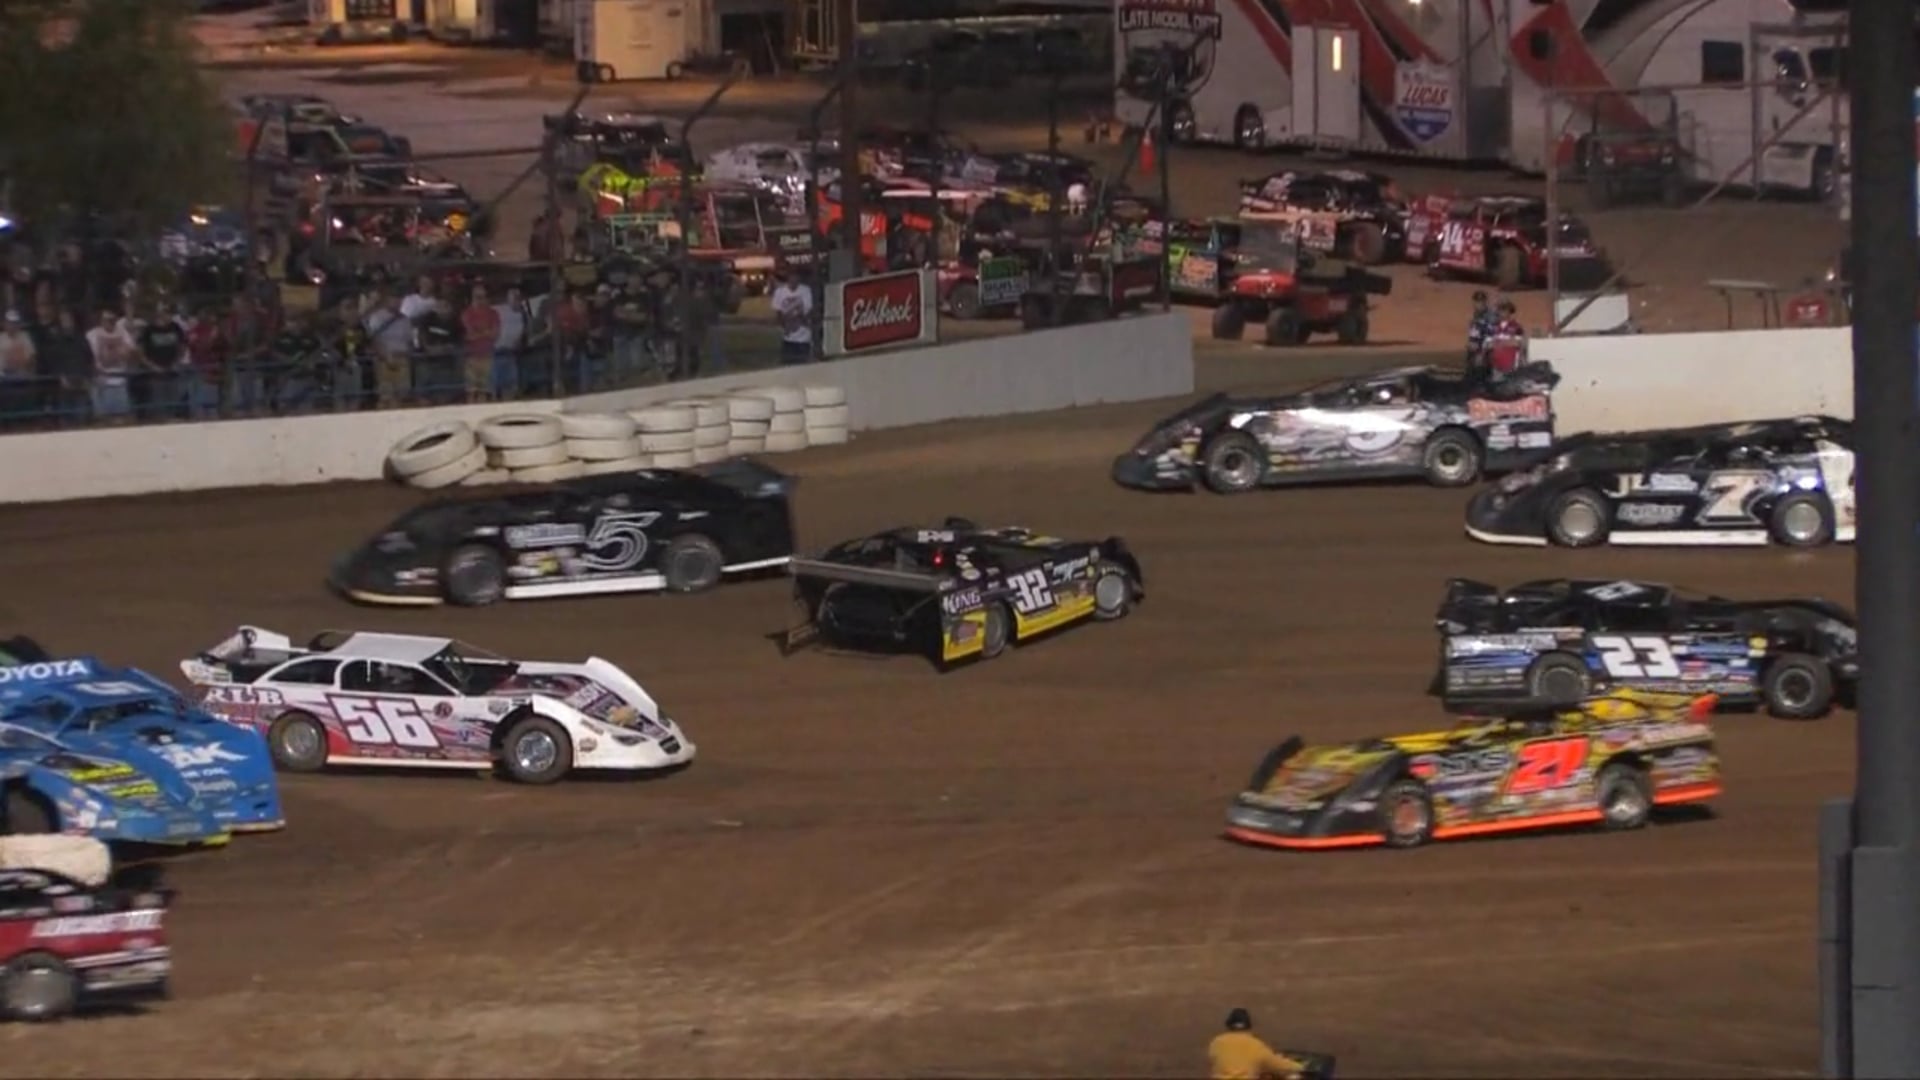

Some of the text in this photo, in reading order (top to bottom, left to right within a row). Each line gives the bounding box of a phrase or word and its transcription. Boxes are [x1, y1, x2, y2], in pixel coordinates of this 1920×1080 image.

[1121, 9, 1219, 38] LATE MODEL DT
[1403, 85, 1449, 106] LUCAS
[1441, 222, 1465, 254] 14
[850, 293, 913, 332] Edelbrock
[581, 511, 663, 571] 5
[942, 588, 982, 614] KING
[1006, 566, 1053, 613] 32
[1593, 636, 1681, 678] 23
[330, 697, 440, 748] 56
[1506, 734, 1589, 794] 21
